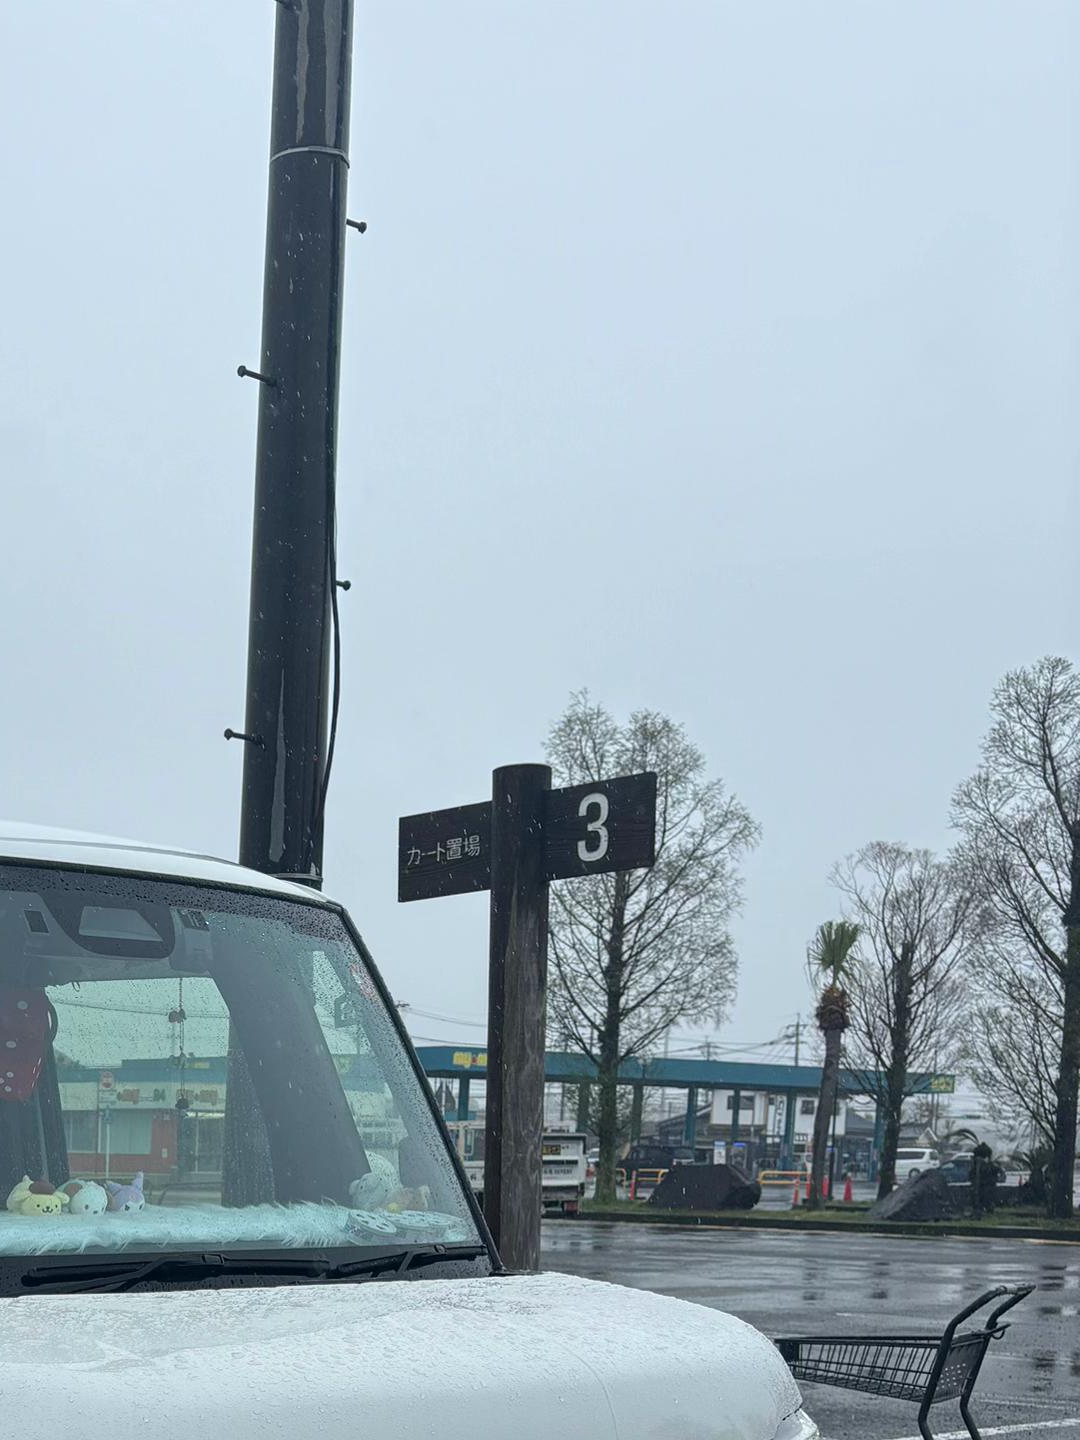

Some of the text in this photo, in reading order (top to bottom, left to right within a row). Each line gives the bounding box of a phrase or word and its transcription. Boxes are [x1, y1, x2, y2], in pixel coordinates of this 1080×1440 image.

[407, 835, 480, 867] カート置場
[577, 792, 610, 863] 3
